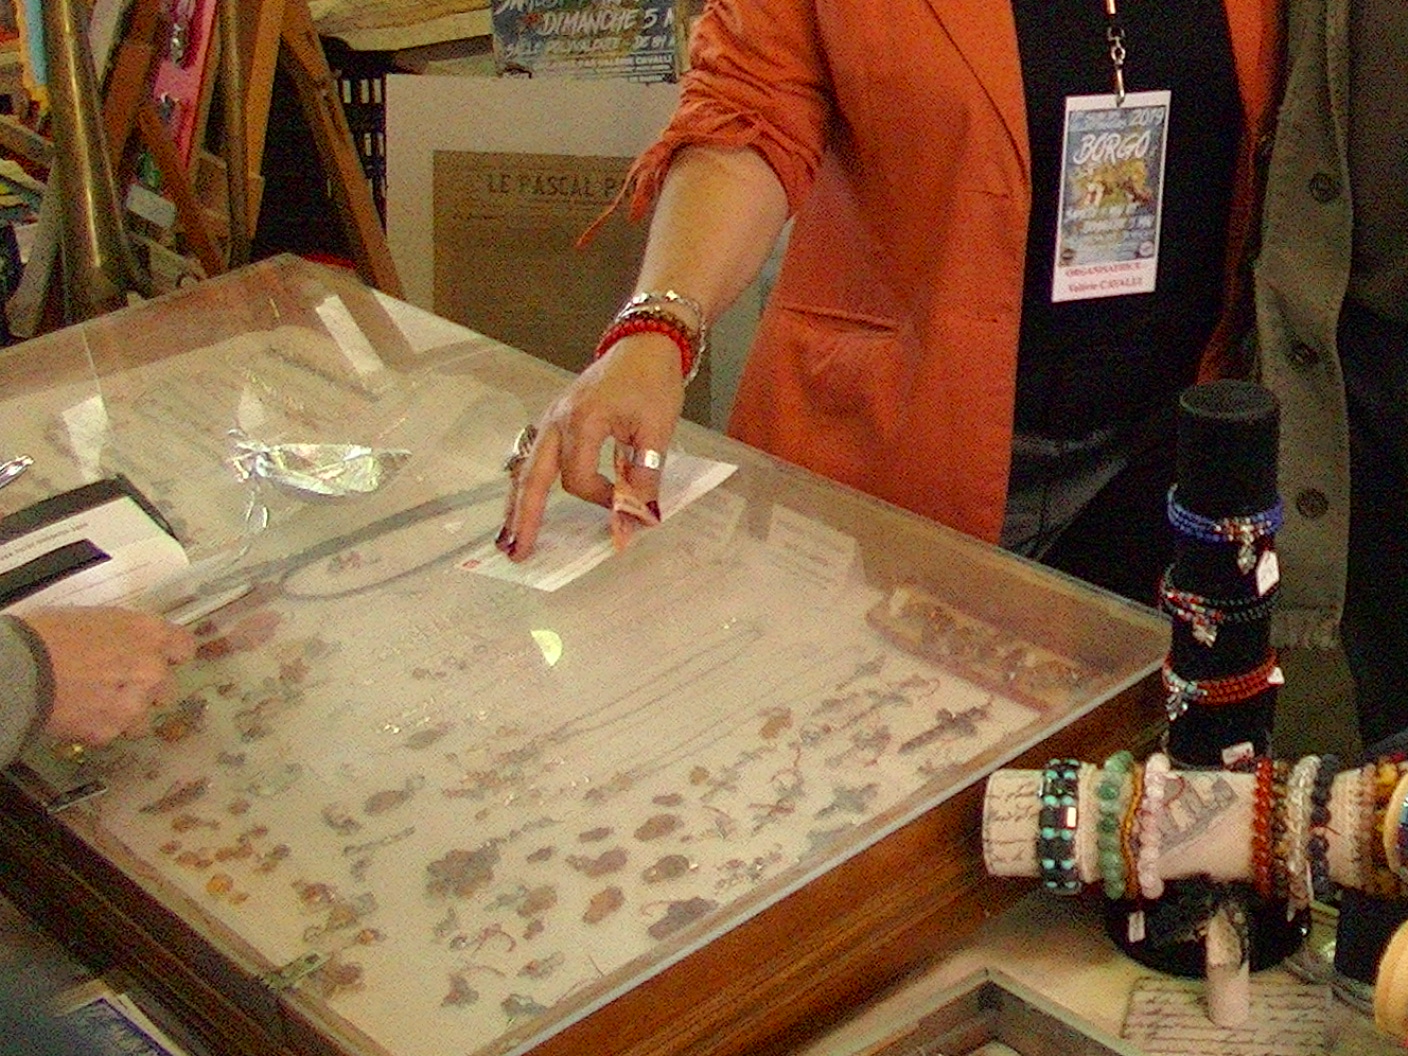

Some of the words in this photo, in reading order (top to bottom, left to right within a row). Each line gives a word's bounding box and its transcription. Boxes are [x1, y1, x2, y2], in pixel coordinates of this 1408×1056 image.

[537, 8, 641, 37] DIMANCHE
[642, 7, 658, 28] 5
[1073, 129, 1151, 165] BORGO
